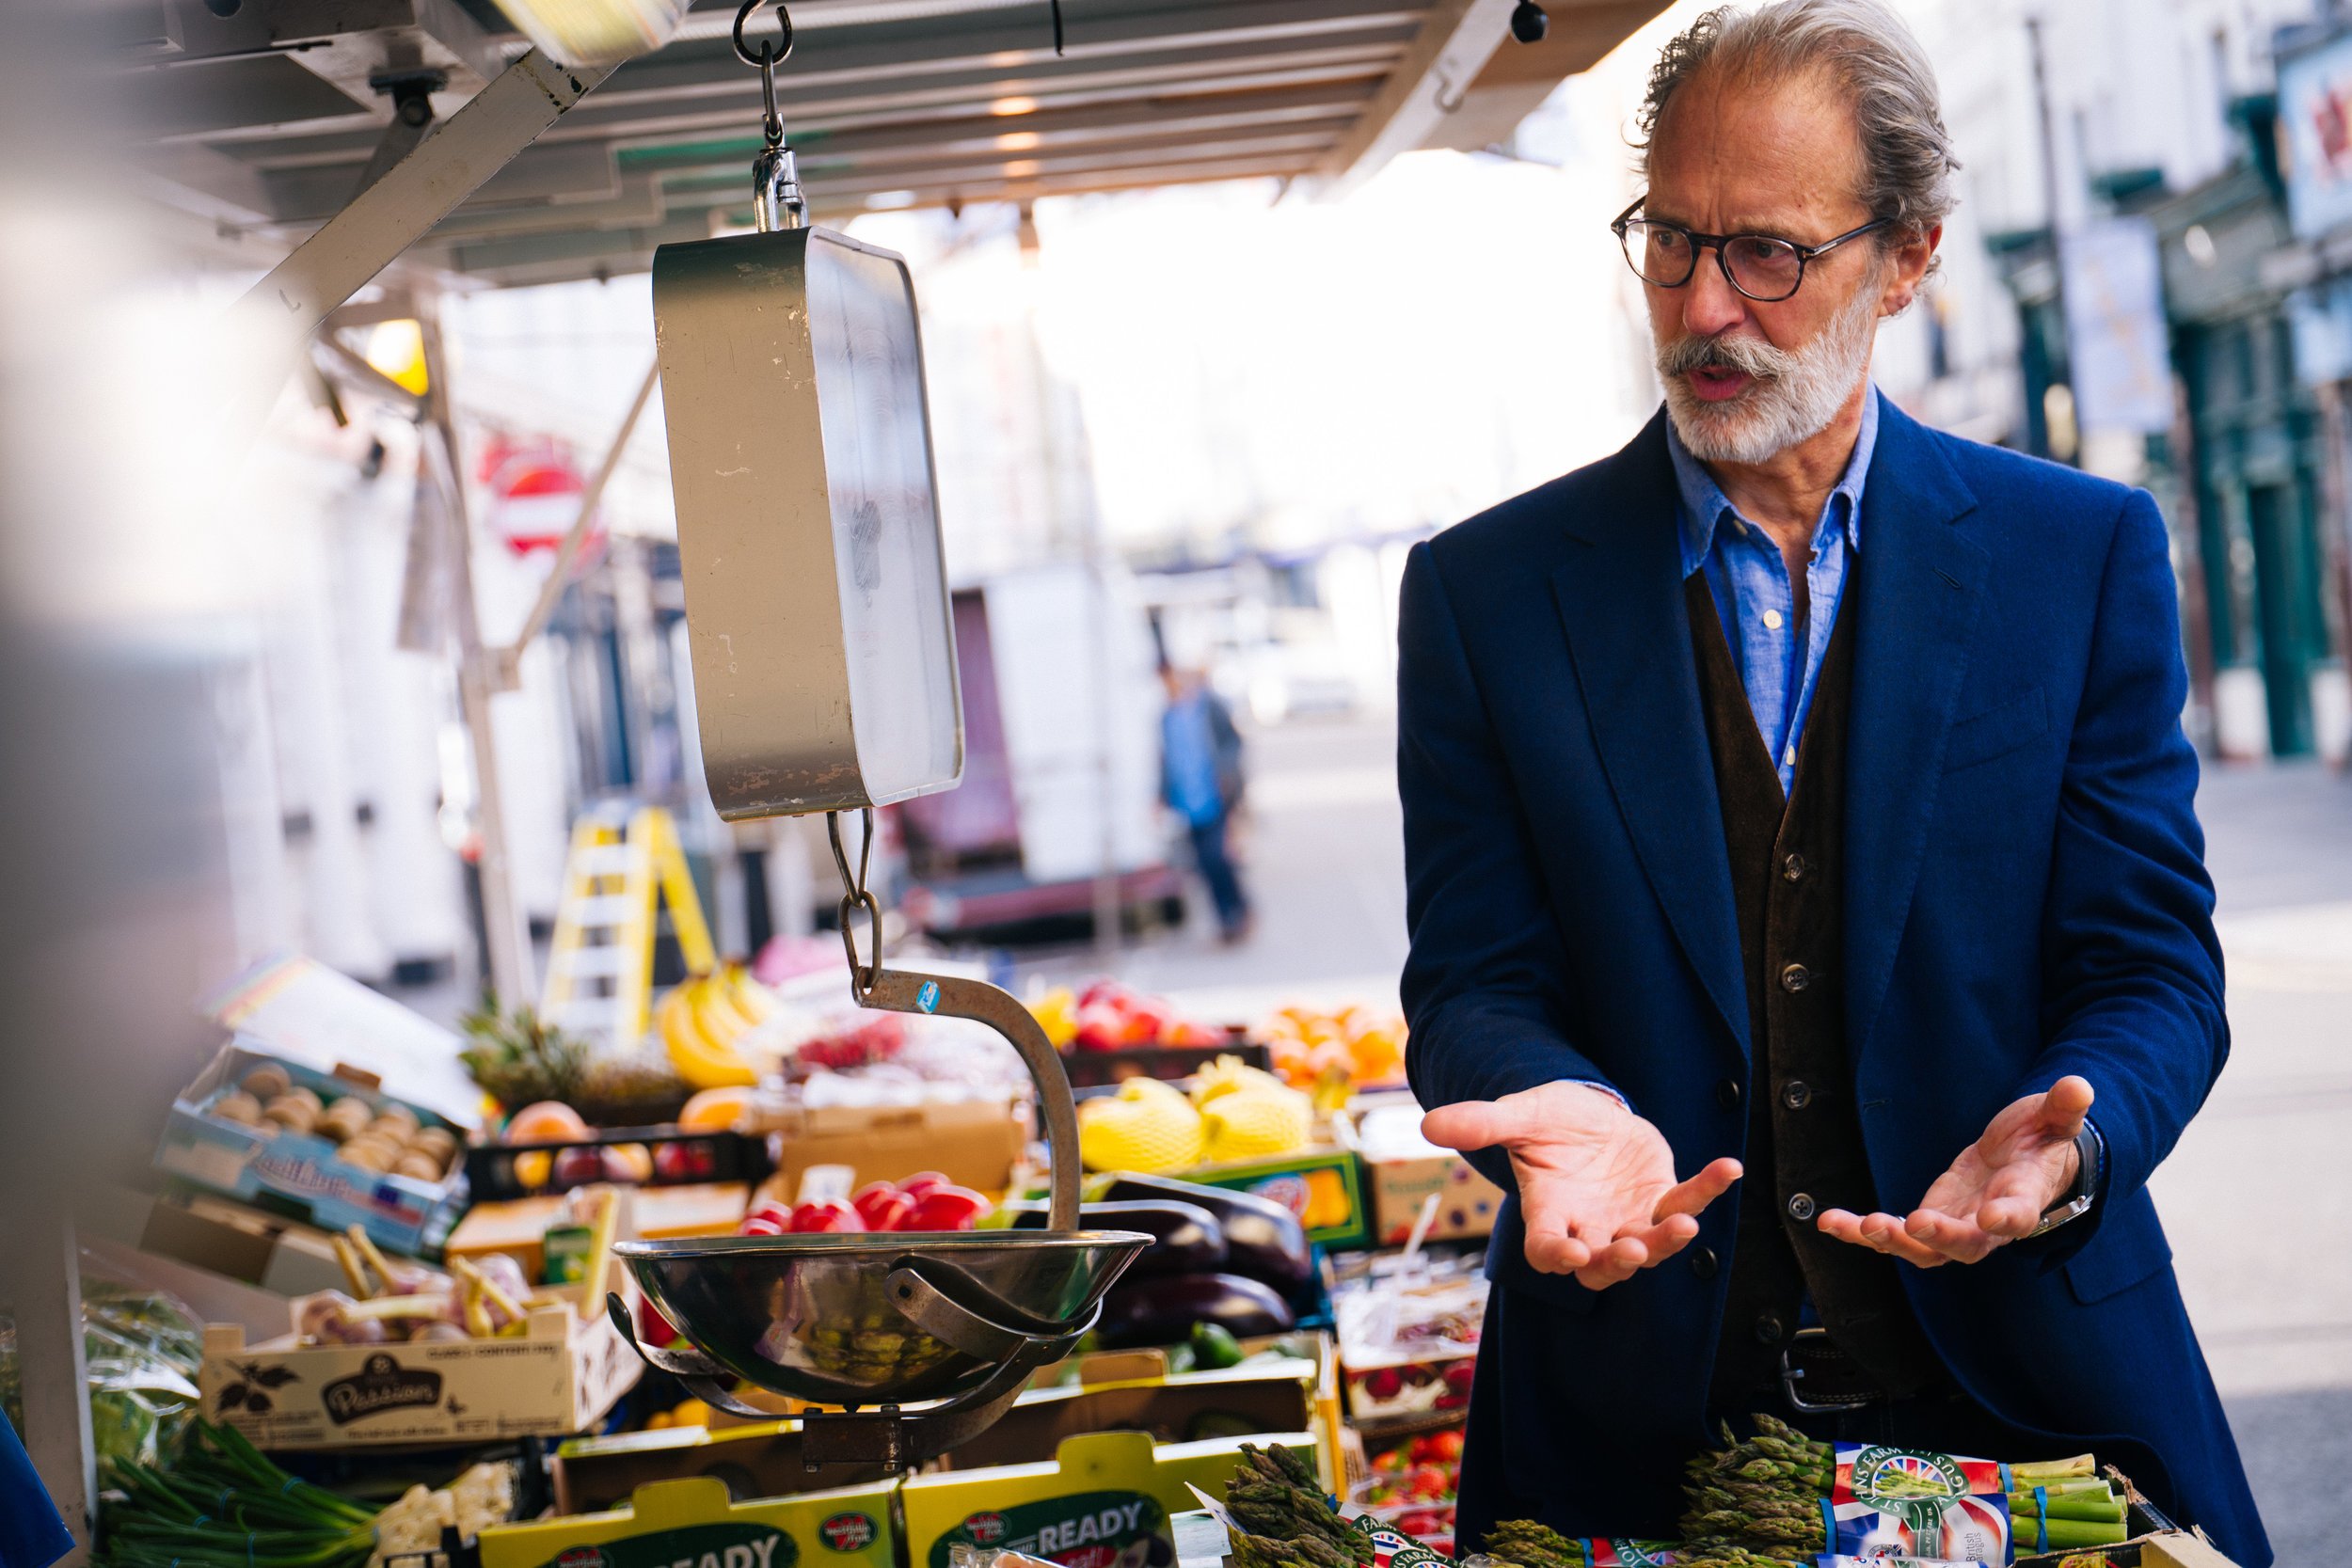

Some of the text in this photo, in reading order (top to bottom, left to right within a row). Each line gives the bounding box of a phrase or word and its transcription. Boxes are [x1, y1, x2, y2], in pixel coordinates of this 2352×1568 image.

[1862, 1447, 1903, 1468] FARM
[1038, 1500, 1144, 1554] READY
[1963, 1532, 1977, 1562] British
